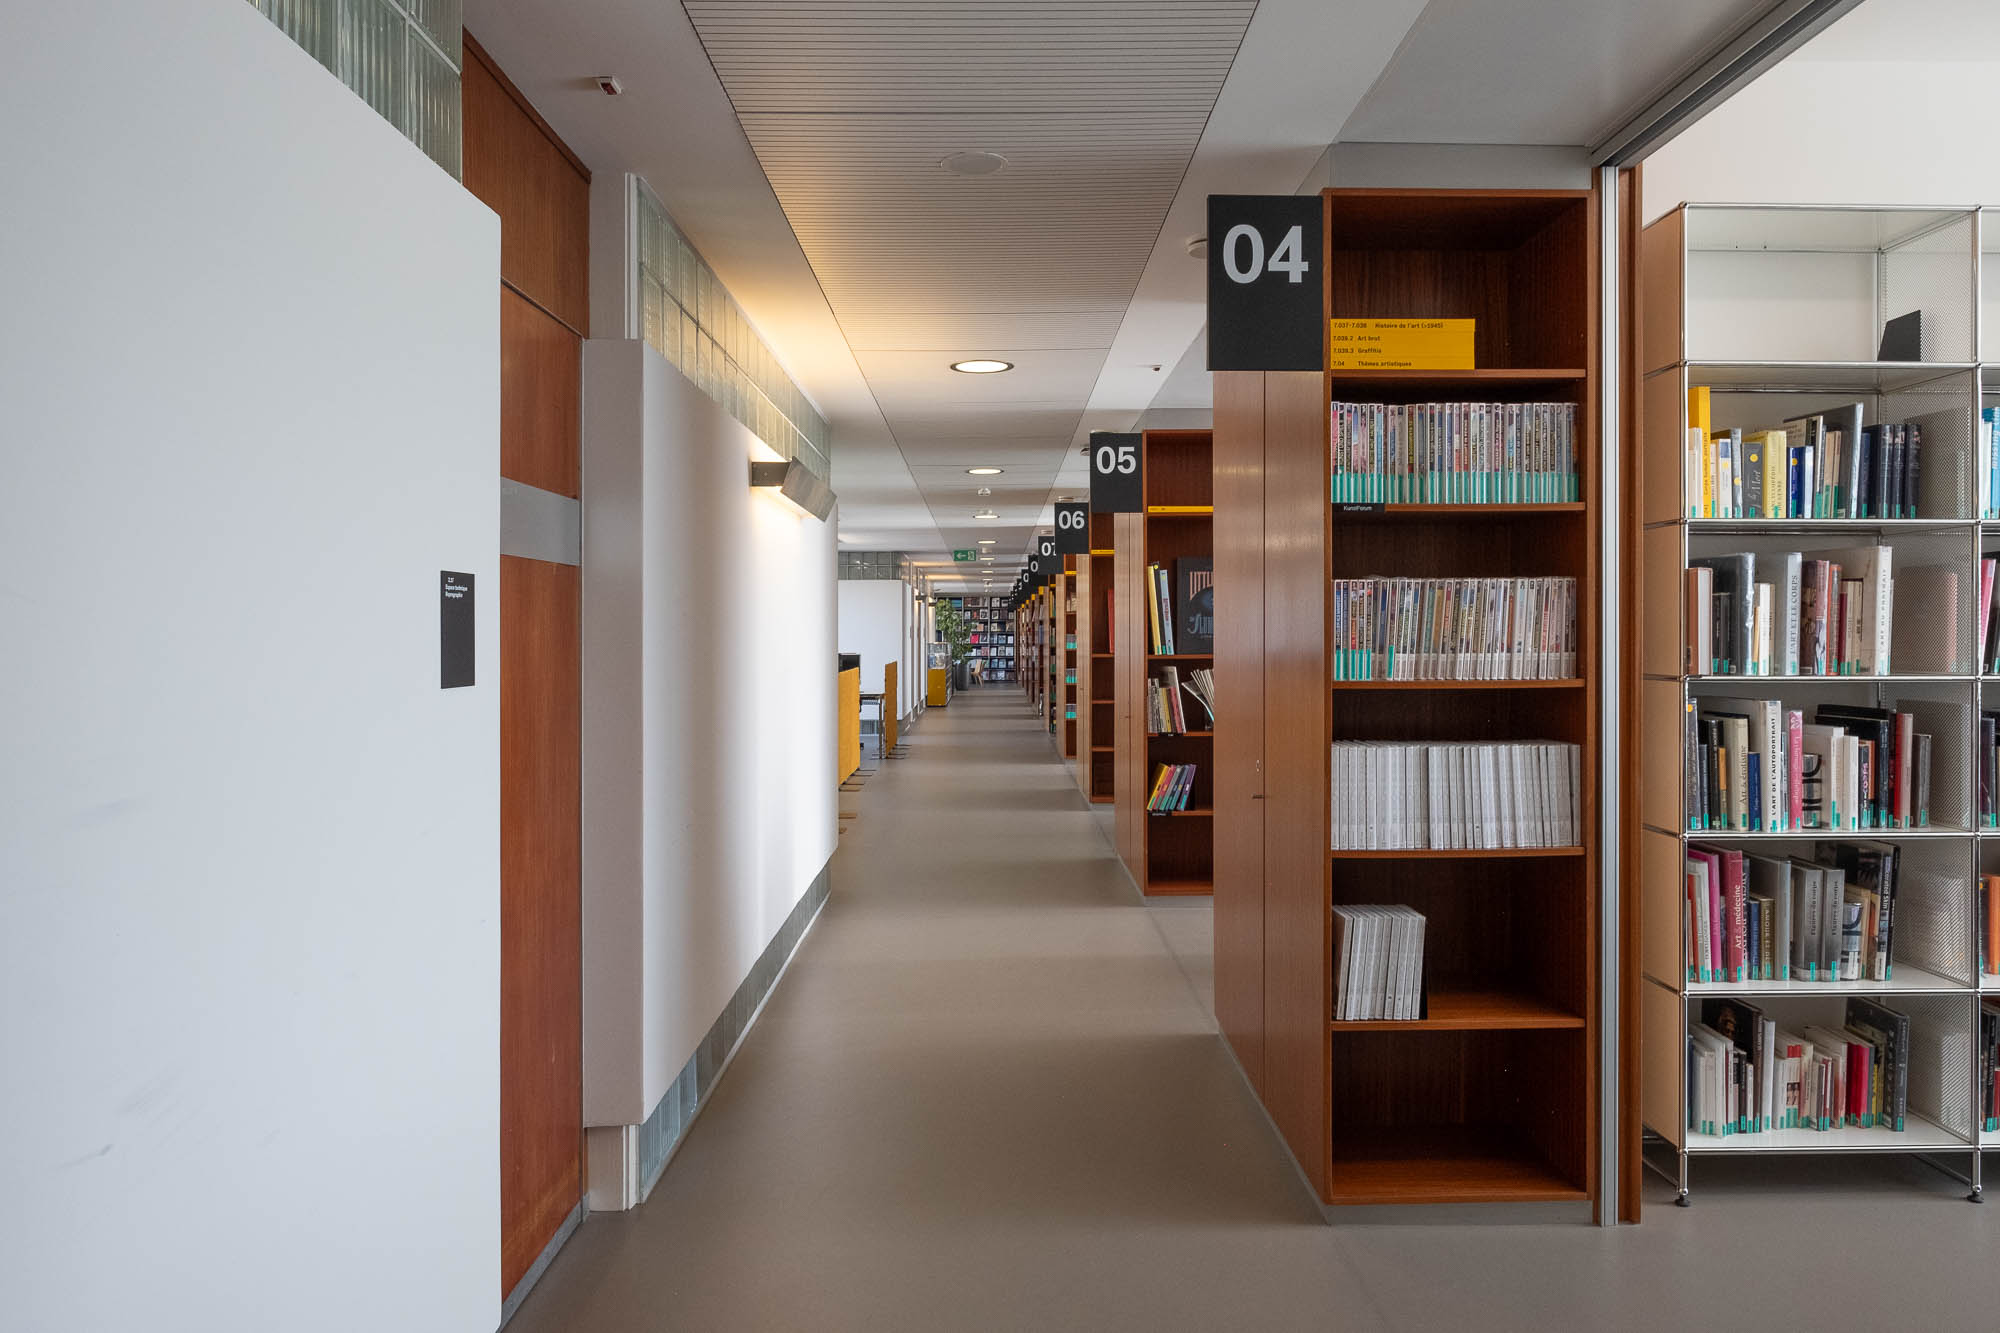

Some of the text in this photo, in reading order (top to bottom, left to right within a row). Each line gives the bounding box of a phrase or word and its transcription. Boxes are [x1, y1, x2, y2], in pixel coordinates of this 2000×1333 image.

[1223, 224, 1308, 284] 04
[1096, 446, 1137, 474] 05
[1058, 510, 1085, 529] 06
[1738, 745, 1747, 780] érotisme
[1738, 792, 1747, 806] Art
[1771, 784, 1776, 792] DE
